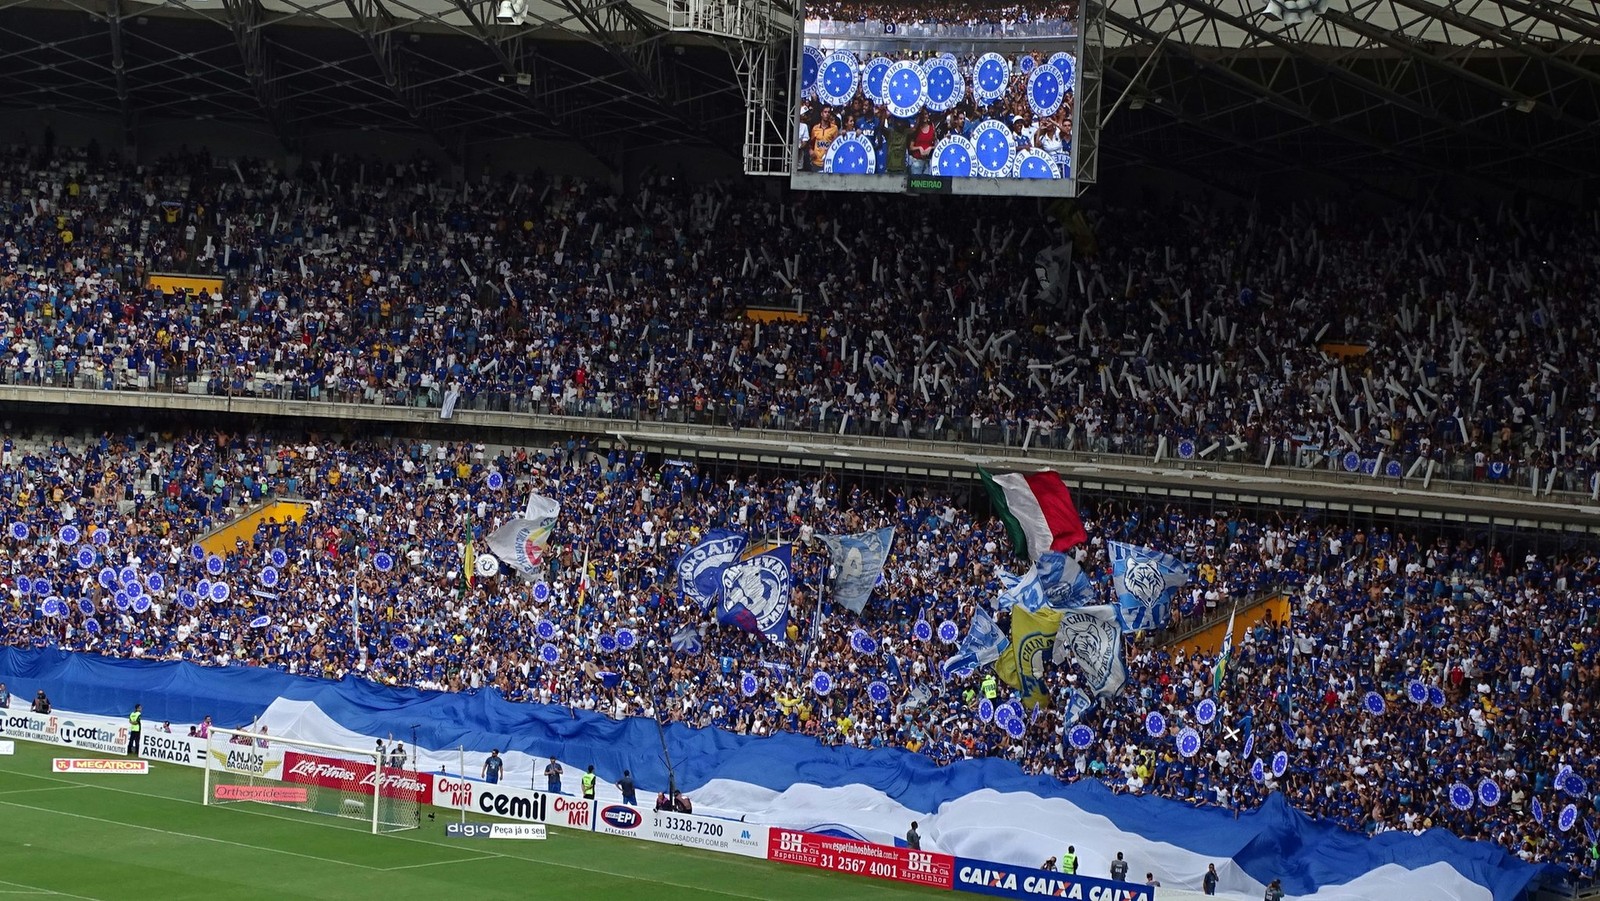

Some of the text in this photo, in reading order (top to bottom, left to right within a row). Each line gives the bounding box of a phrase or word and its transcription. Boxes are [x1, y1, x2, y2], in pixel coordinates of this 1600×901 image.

[865, 58, 892, 75] CRUZEIR
[972, 121, 1010, 141] CRUZEIRO
[10, 717, 45, 731] cottar
[77, 727, 115, 742] cottar
[143, 735, 191, 753] ESCOLTA
[142, 746, 191, 763] ARMADA
[227, 750, 264, 766] ANJOS
[76, 761, 142, 769] MEGATRON
[236, 762, 263, 773] GUADA
[452, 791, 472, 807] Mil
[479, 792, 546, 821] cemil
[554, 797, 588, 812] Choco
[568, 810, 589, 826] Mil
[618, 812, 636, 825] EPI
[447, 823, 490, 837] digio
[494, 826, 513, 836] Peça
[515, 826, 522, 836] já
[605, 828, 637, 837] ATACADISTA
[653, 817, 724, 837] 31 3328-7200
[653, 831, 729, 849] WWW.CASADOEPI.COM.BR
[732, 838, 759, 847] MARLUVAS
[780, 832, 803, 853] BH
[774, 850, 817, 863] Espetinhos
[908, 852, 933, 873] BH
[820, 854, 898, 879] 31 2567 4001
[902, 870, 947, 884] Espetinhos
[959, 867, 1017, 891] CAIXA
[1023, 876, 1083, 901] CAIXA
